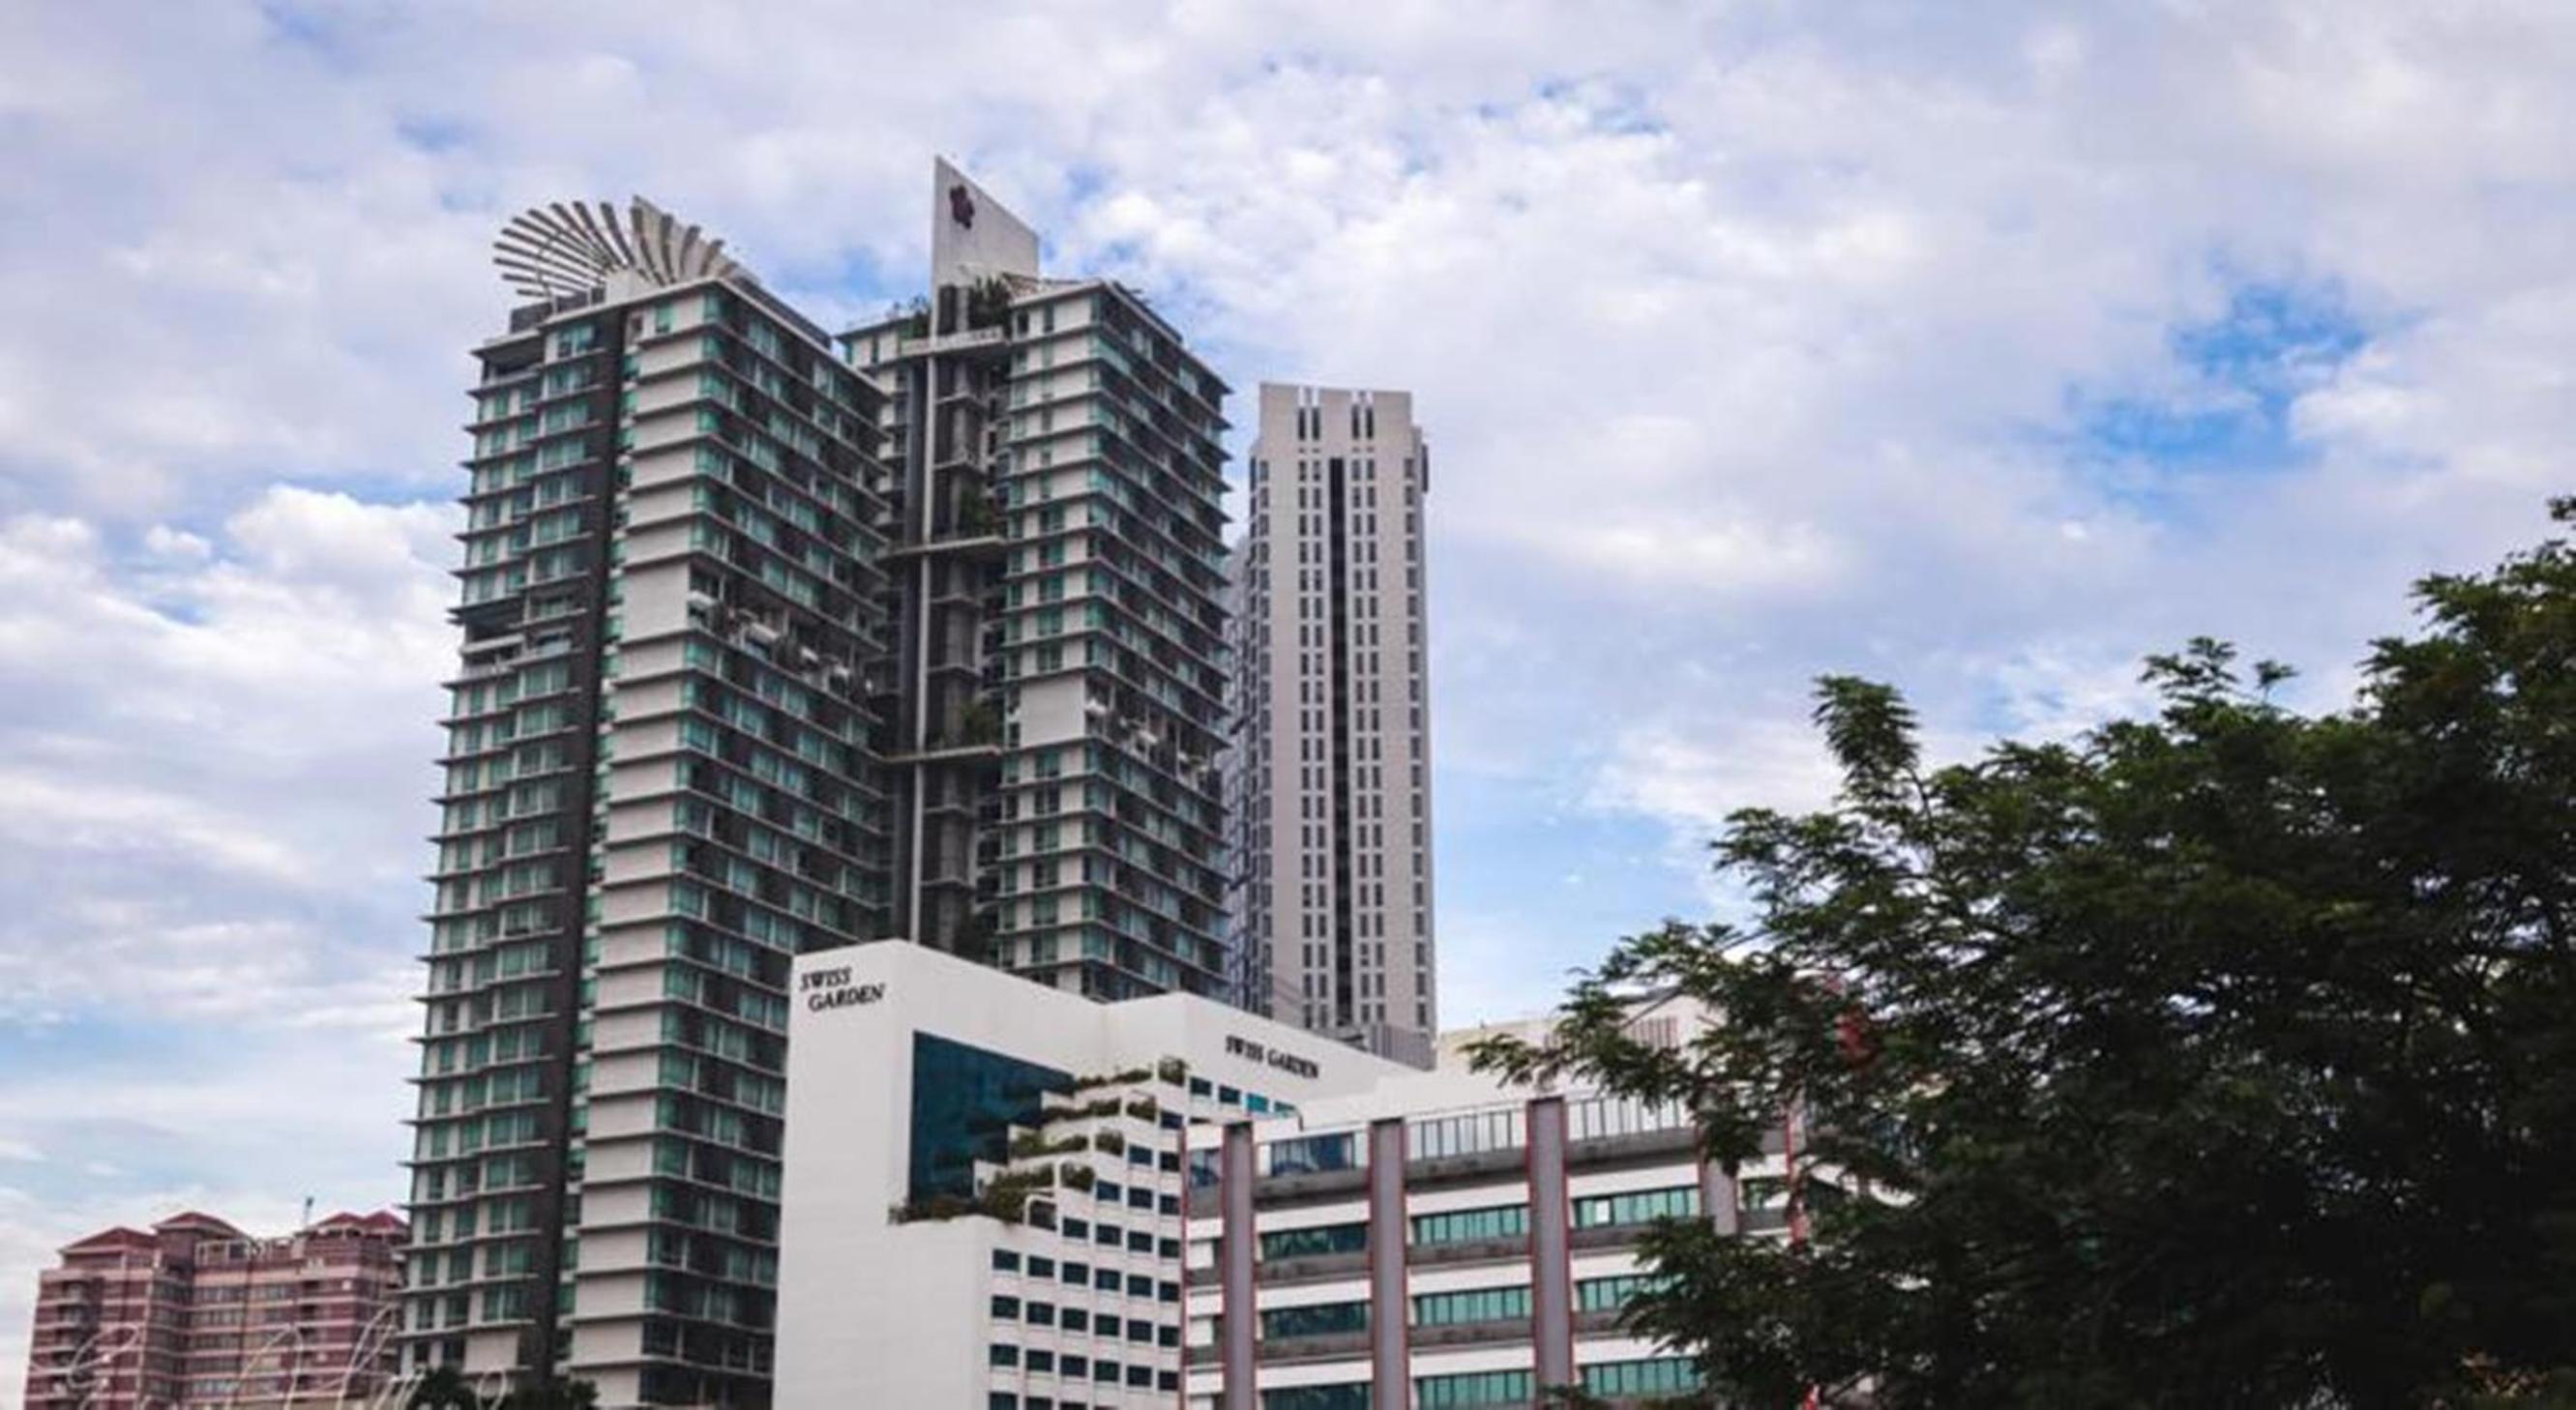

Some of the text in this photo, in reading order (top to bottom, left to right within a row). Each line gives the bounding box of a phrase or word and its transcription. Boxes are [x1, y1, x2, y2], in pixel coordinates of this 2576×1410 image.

[800, 966, 851, 992] SWISS
[808, 983, 886, 1012] GARDEN
[1226, 1035, 1318, 1078] SWISS GARDEN
